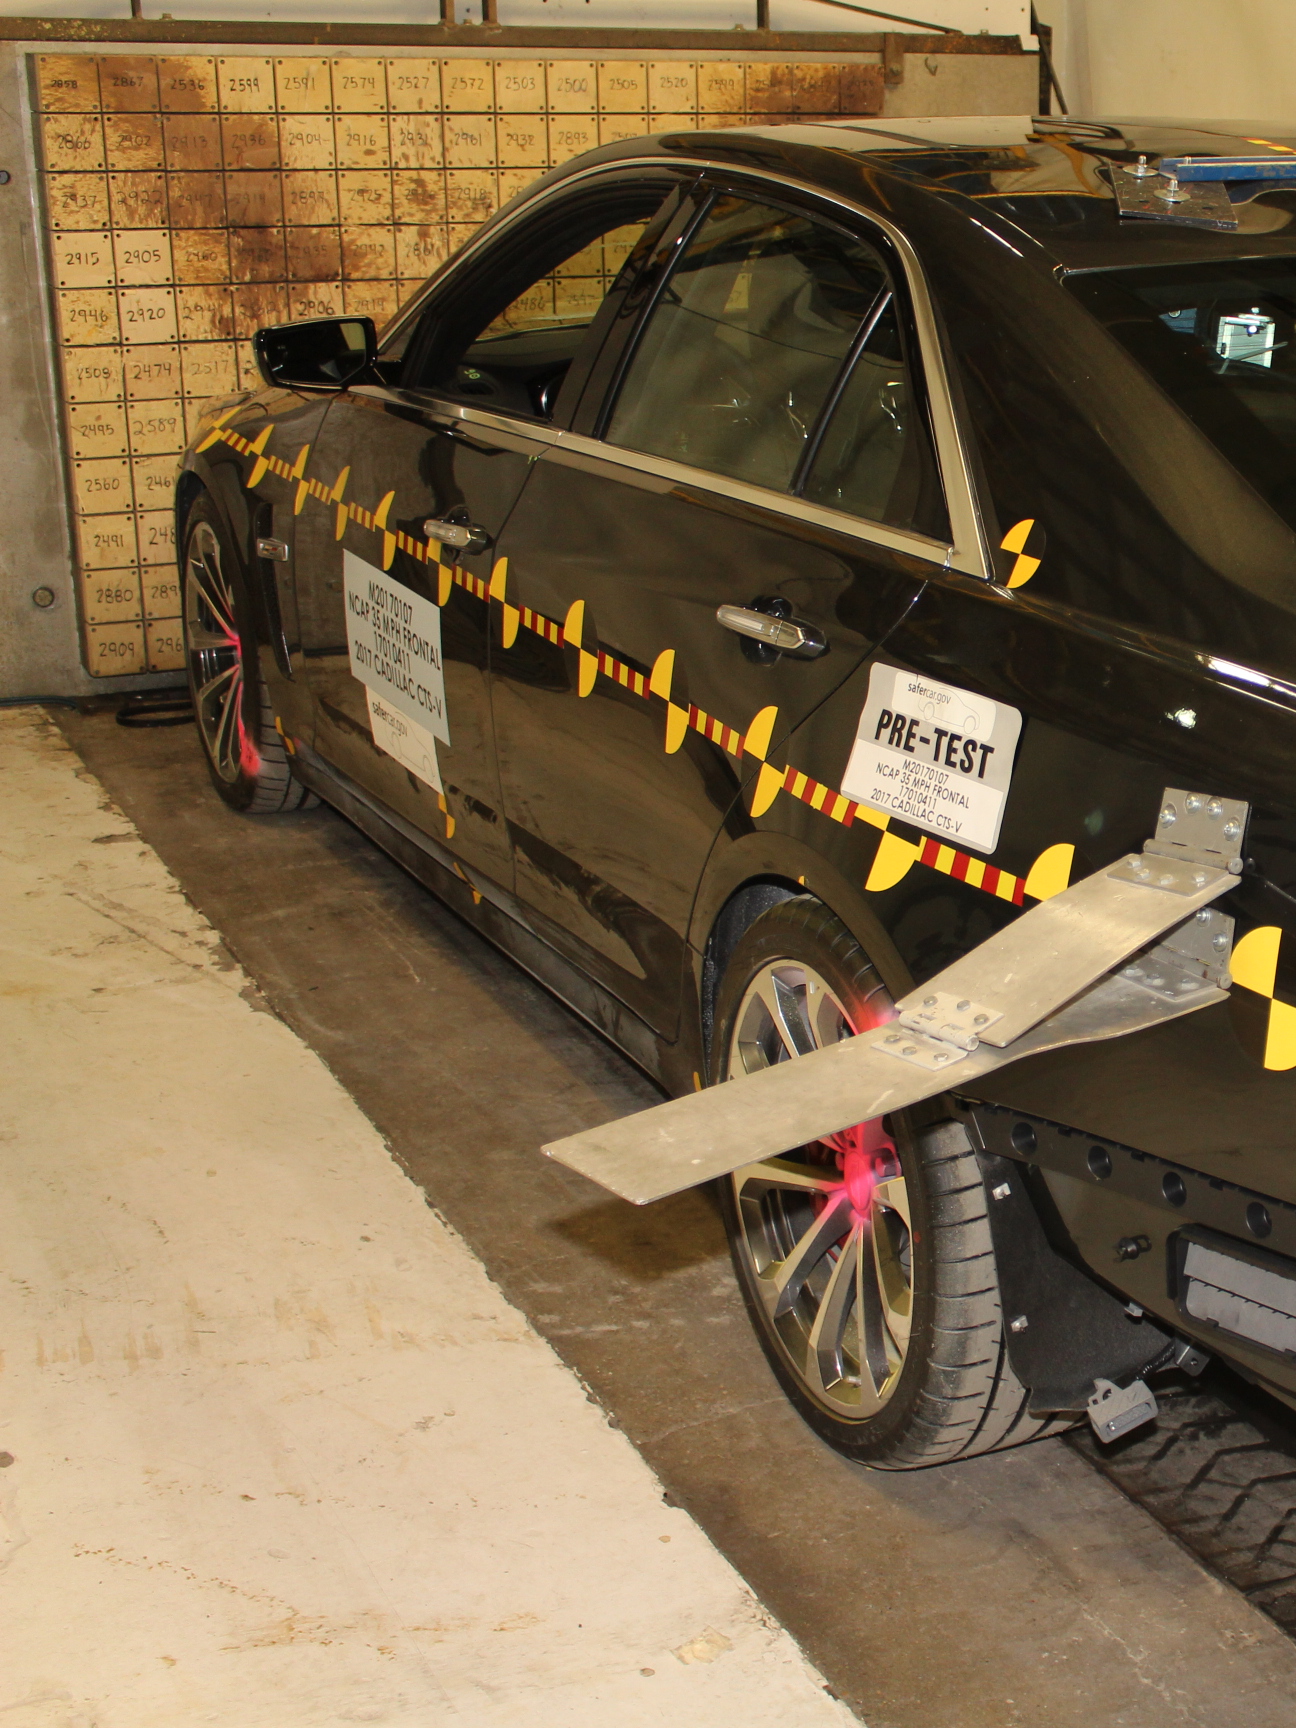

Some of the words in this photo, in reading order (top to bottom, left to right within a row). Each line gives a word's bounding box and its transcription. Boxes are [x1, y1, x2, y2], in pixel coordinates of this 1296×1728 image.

[50, 79, 78, 89] 2858
[112, 75, 144, 87] 2867
[170, 78, 205, 91] 2536
[229, 77, 260, 93] 2599
[283, 76, 316, 90] 2591
[342, 76, 376, 89] 2574
[397, 76, 430, 90] 2527
[450, 77, 485, 90] 2572
[505, 76, 536, 90] 2503
[609, 78, 638, 90] 2505
[659, 76, 689, 89] 2520
[57, 133, 92, 150] 2866
[288, 132, 322, 147] 2904
[346, 132, 377, 147] 2916
[558, 131, 589, 146] 2893
[116, 190, 164, 207] 2922
[65, 251, 100, 266] 2915
[123, 249, 162, 264] 2905
[69, 308, 108, 323] 2946
[126, 307, 166, 323] 2920
[298, 300, 335, 316] 2906
[133, 362, 172, 380] 2474
[191, 359, 230, 375] 2517
[80, 424, 115, 438] 2495
[132, 417, 177, 436] 2589
[85, 478, 120, 493] 2560
[93, 534, 125, 548] 2491
[149, 527, 176, 546] 248
[96, 588, 134, 604] 2880
[151, 585, 178, 599] 289
[368, 580, 413, 626] M20170107
[348, 590, 370, 622] NCAP
[371, 605, 382, 630] 35
[382, 612, 402, 644] MPH
[402, 625, 441, 671] FRONTAL
[99, 642, 135, 658] 2909
[156, 637, 183, 654] 296
[374, 630, 412, 674] 17010411
[354, 639, 372, 669] 2017
[374, 653, 416, 701] CADILLAC
[416, 683, 442, 720] CTS-V
[907, 681, 952, 705] safercar.gov
[874, 708, 996, 780] PRE-TEST
[902, 758, 950, 786] M20170107
[875, 761, 900, 782] NCAP
[899, 771, 912, 786] 35
[911, 774, 931, 793] MPH
[932, 781, 970, 810] FRONTAL
[899, 784, 938, 810] 17010411
[870, 788, 892, 807] 2017
[891, 793, 935, 823] CADILLAC
[935, 813, 963, 834] CTS-V
